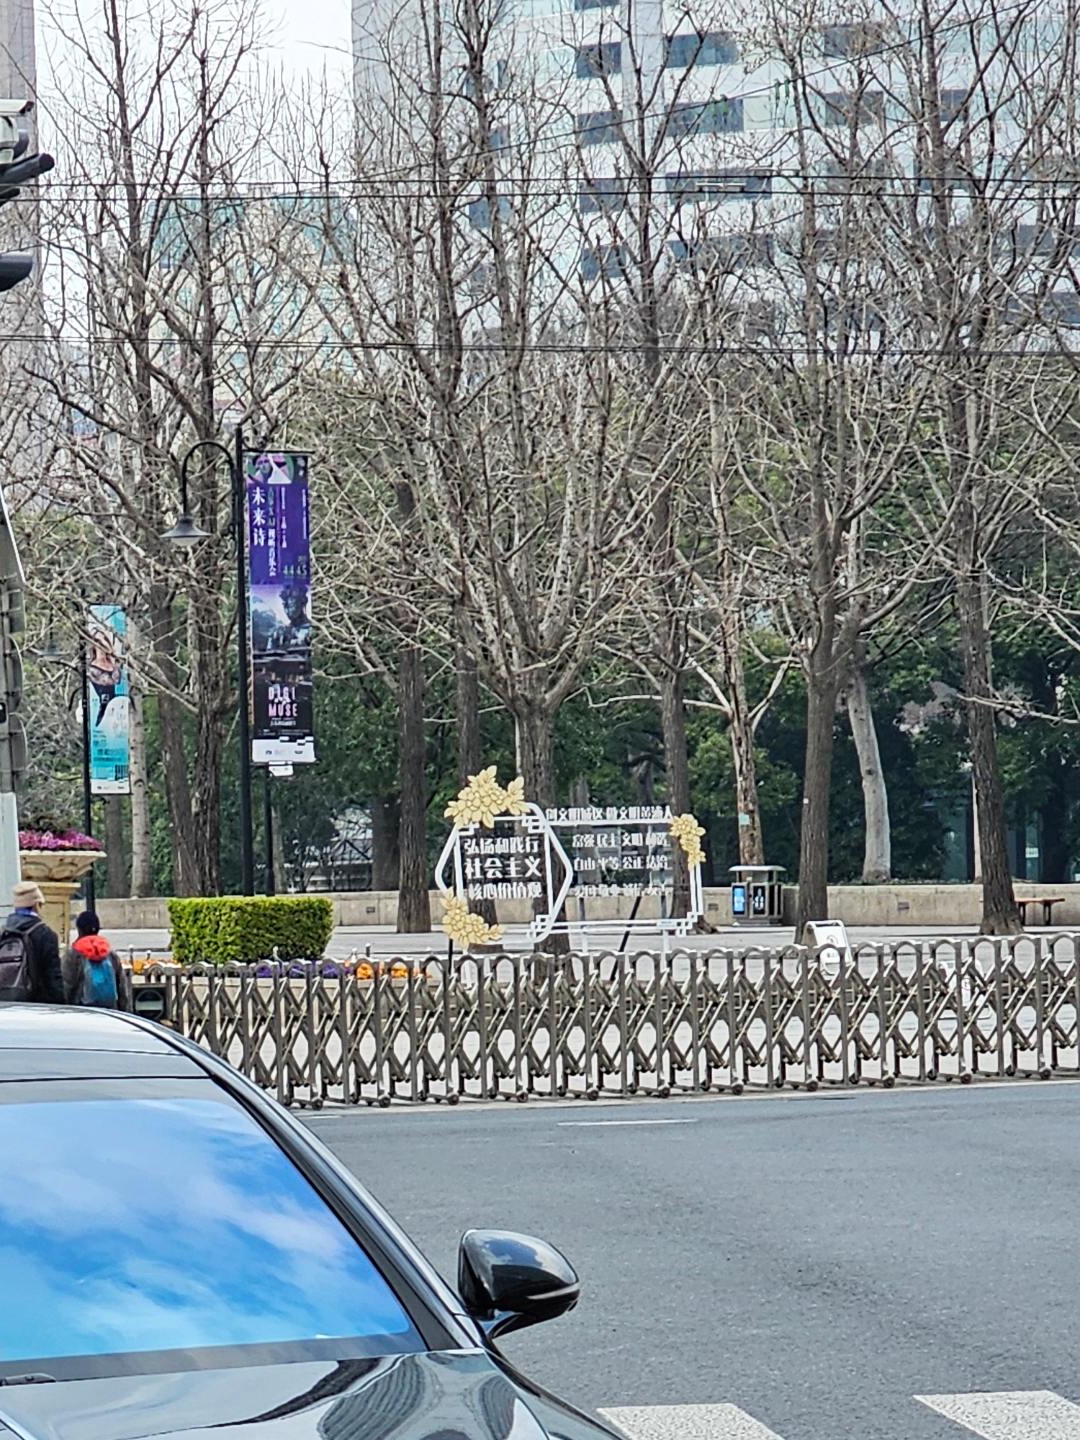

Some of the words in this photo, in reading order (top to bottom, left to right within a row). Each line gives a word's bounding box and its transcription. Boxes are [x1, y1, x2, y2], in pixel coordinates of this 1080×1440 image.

[268, 686, 296, 700] DIGI
[268, 703, 298, 717] MUSE
[463, 836, 539, 855] 弘扬和践行
[463, 856, 542, 879] 社会主义
[468, 882, 542, 900] 核心价值观
